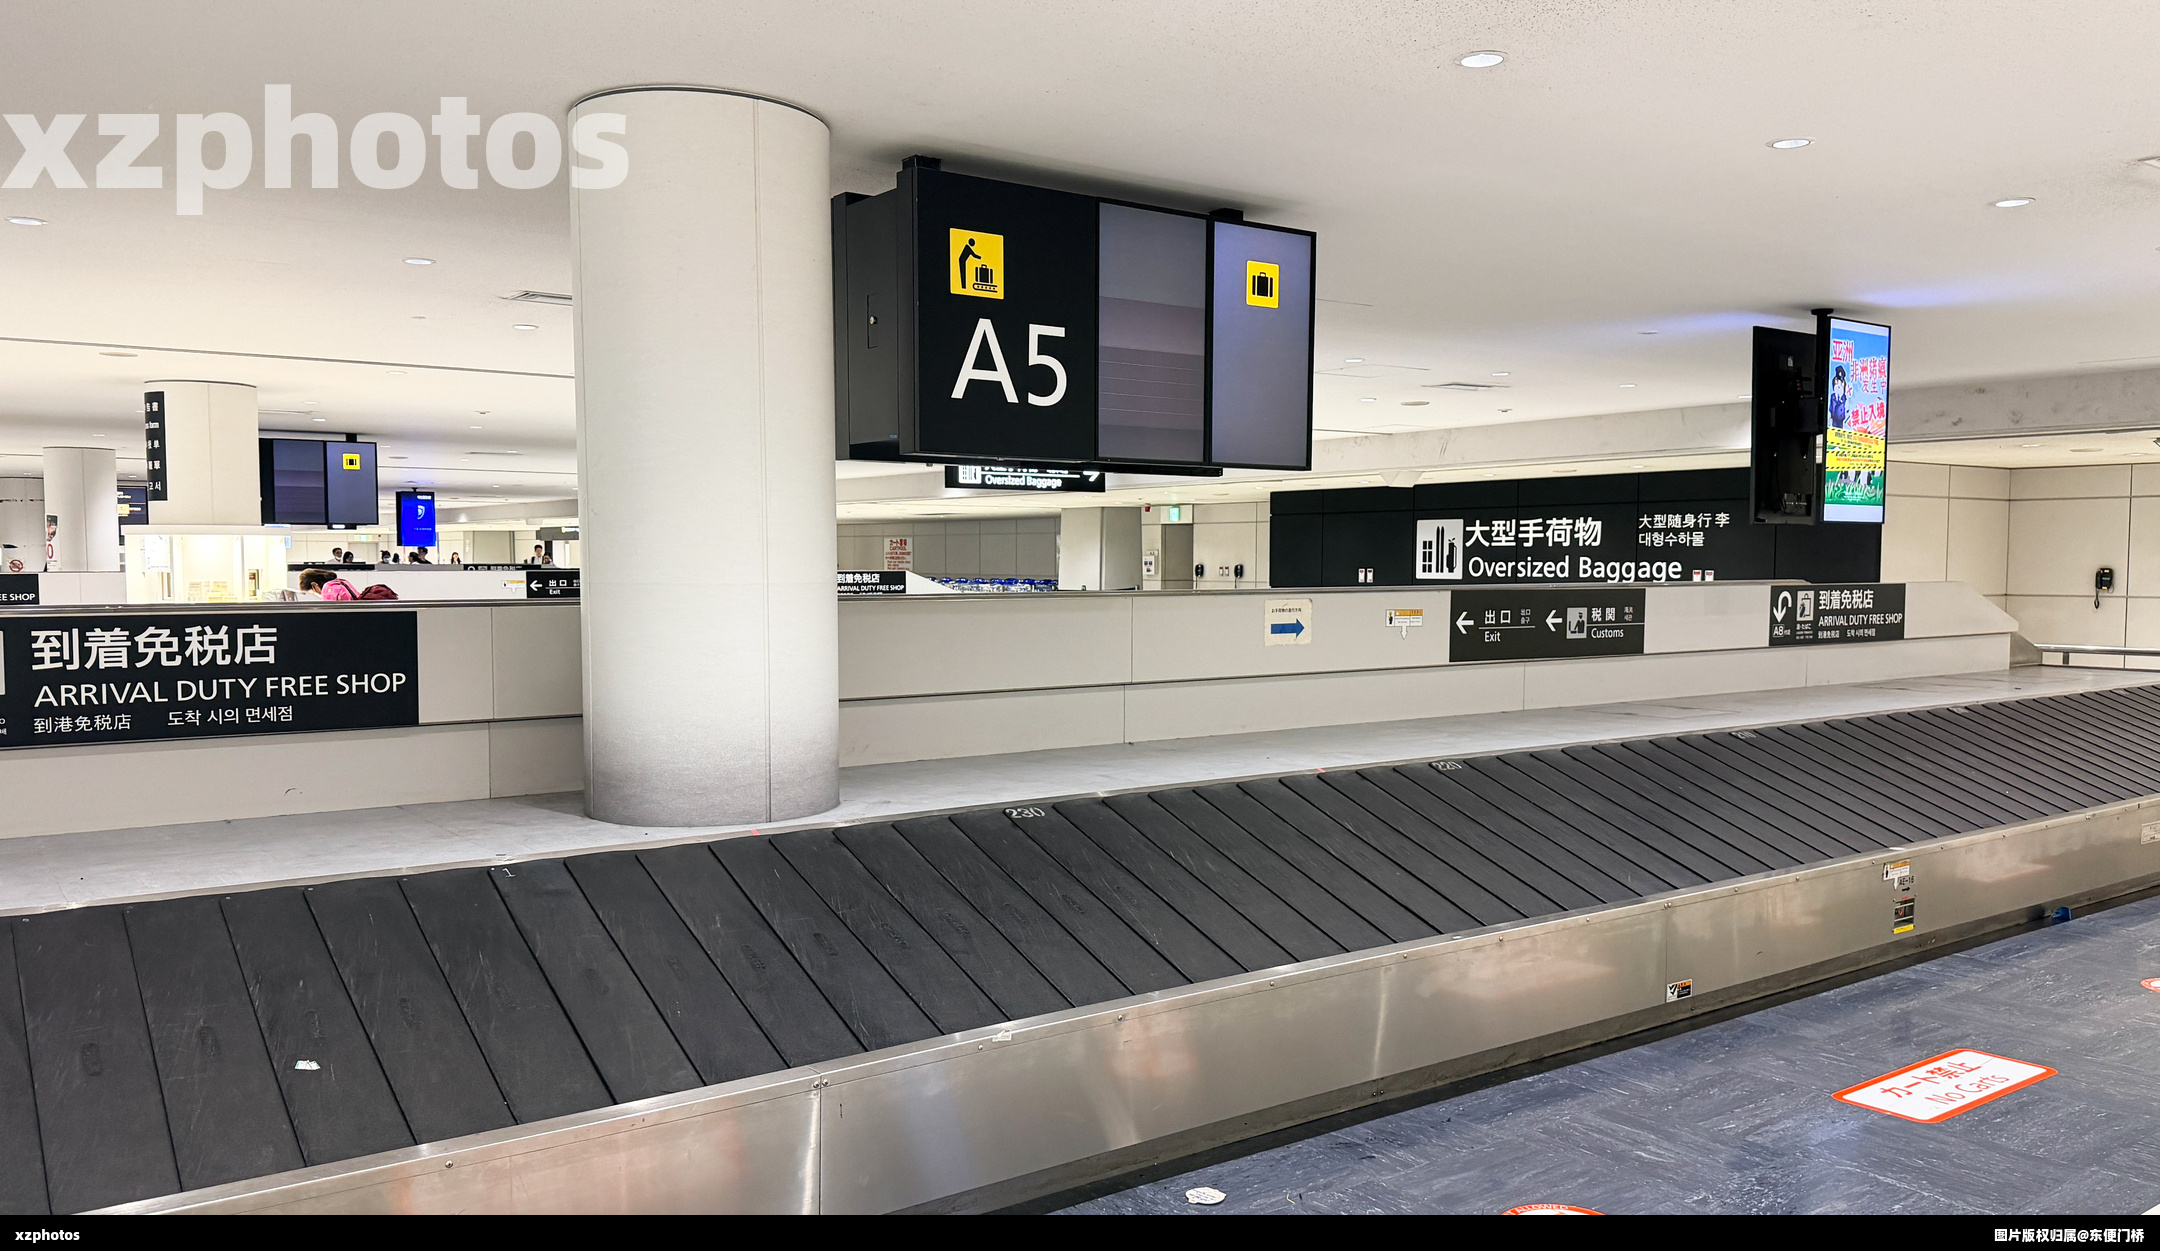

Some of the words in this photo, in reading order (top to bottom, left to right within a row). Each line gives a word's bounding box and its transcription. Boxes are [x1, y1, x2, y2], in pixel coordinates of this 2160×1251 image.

[951, 317, 1067, 406] A5
[985, 474, 1025, 486] Oversized
[1027, 476, 1062, 489] Baggage
[1465, 517, 1602, 548] 大型手荷物
[1468, 555, 1570, 578] Oversized
[1579, 557, 1683, 583] Baggage
[9, 593, 36, 601] SHOP
[1818, 589, 1874, 610] 到着免税店
[1484, 609, 1511, 625] 出口
[1591, 607, 1616, 622] 税関
[1818, 614, 1848, 627] ARRIVAL
[1849, 613, 1868, 626] DUTY
[1869, 612, 1884, 625] FREE
[1885, 612, 1903, 624] SHOP
[1484, 631, 1501, 642] Exit
[1591, 627, 1624, 639] Customs
[1773, 626, 1784, 636] A8
[31, 624, 278, 671] 到着免税店
[34, 681, 168, 708] ARRIVAL
[177, 677, 258, 702] DUTY
[266, 674, 328, 698] FREE
[336, 672, 407, 695] SHOP
[33, 713, 132, 734] 到港免税店
[167, 709, 202, 726] 도착
[207, 707, 239, 725] 시의
[245, 705, 293, 724] 면세점
[1431, 761, 1463, 770] 220
[1005, 807, 1046, 819] 230
[1880, 1062, 1983, 1098] カート禁止
[1924, 1092, 1961, 1105] No
[1955, 1074, 2010, 1094] Carts
